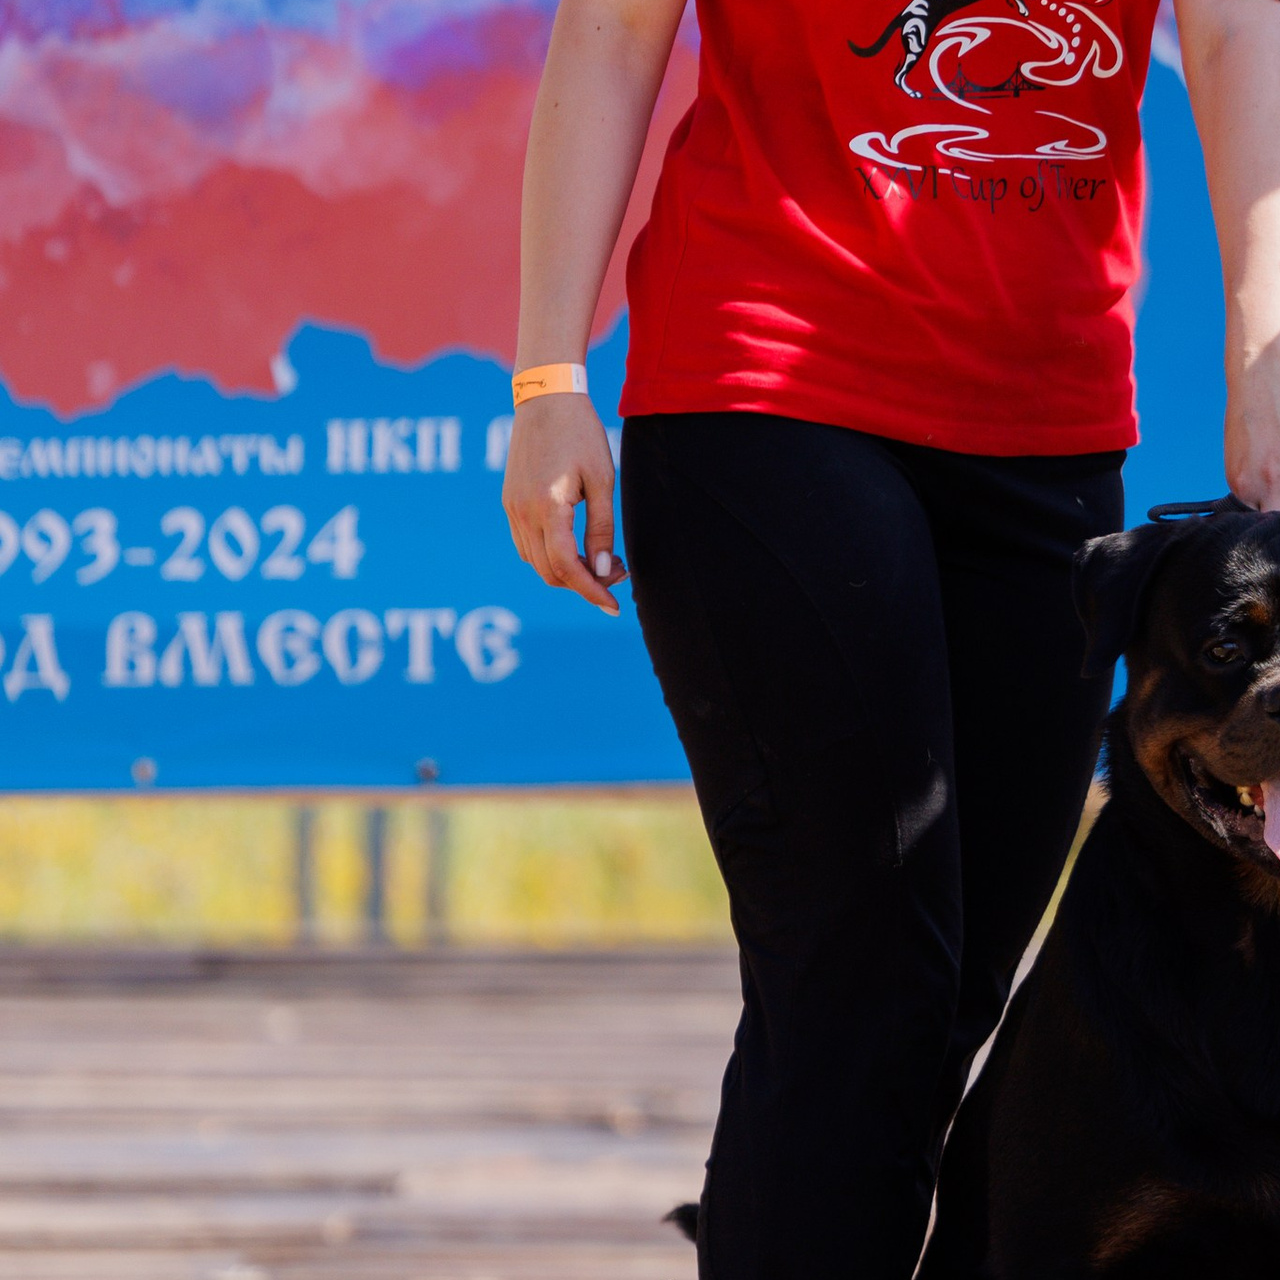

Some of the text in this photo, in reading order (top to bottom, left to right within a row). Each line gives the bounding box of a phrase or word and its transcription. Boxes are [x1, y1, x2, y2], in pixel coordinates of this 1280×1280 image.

[950, 166, 1007, 214] Cup
[1019, 159, 1049, 212] of
[1050, 164, 1106, 201] Tver
[102, 605, 522, 688] ВМЕСТЕ
